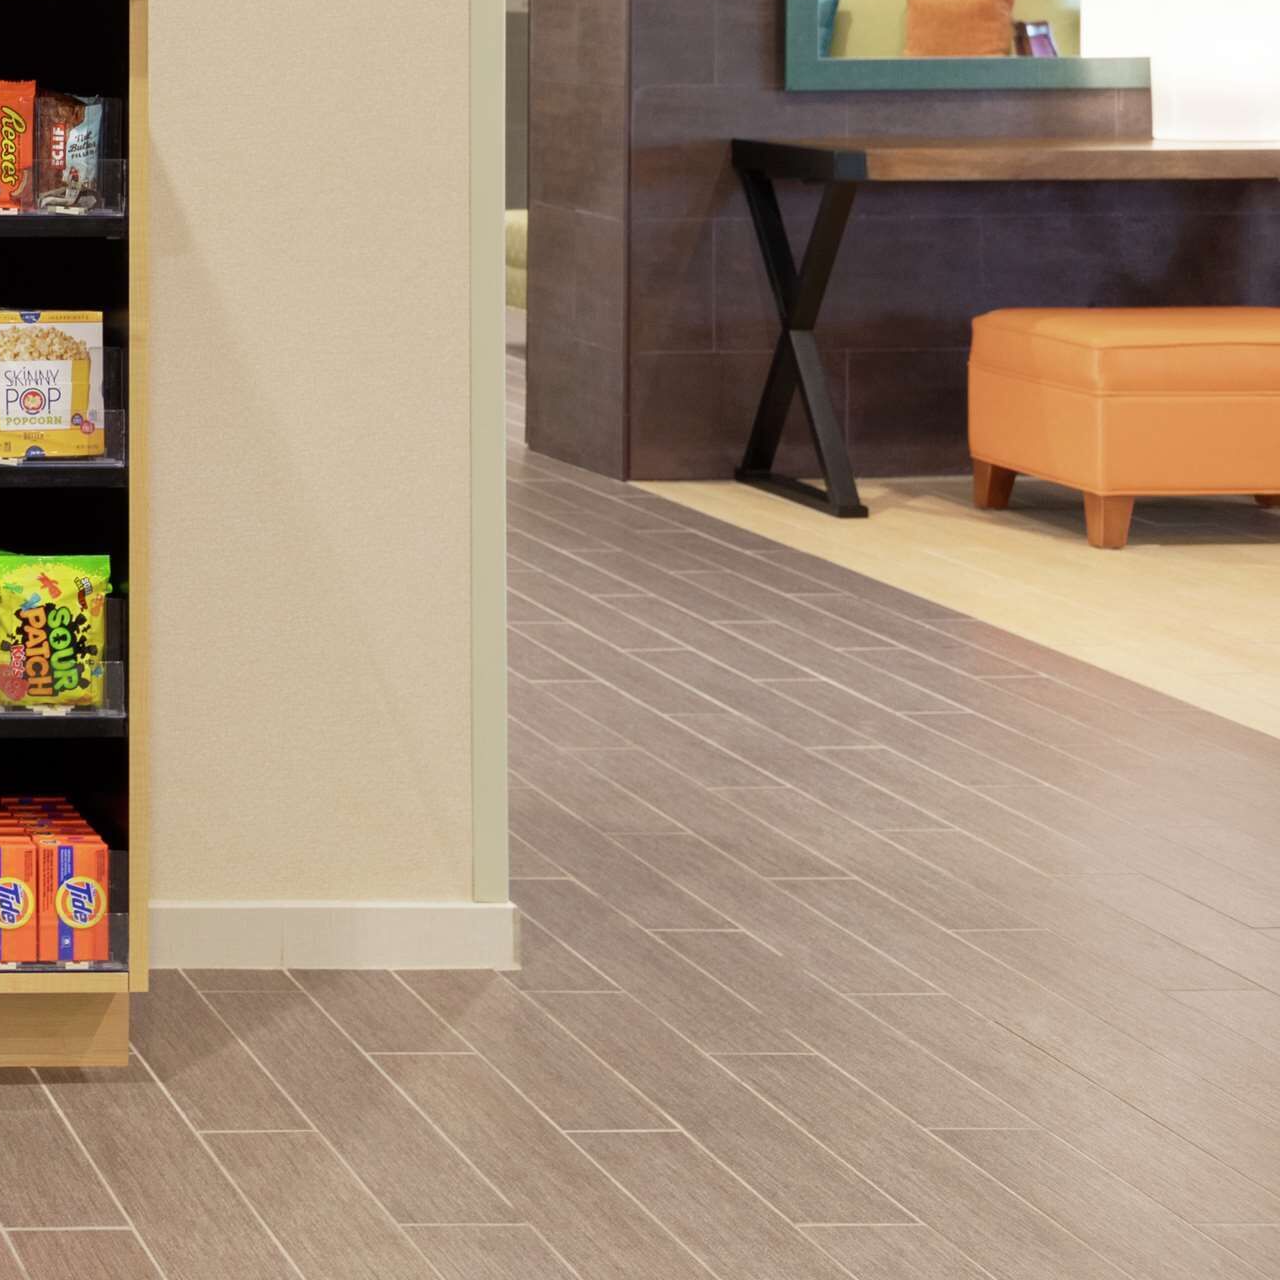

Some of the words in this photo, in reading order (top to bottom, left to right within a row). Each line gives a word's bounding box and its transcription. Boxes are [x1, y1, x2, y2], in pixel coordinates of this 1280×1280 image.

[1, 106, 26, 185] Reese's
[51, 127, 64, 158] CLIF
[6, 416, 62, 425] POPCORN
[20, 607, 53, 696] PATCH
[48, 607, 79, 690] SOUR
[65, 882, 93, 924] Tide
